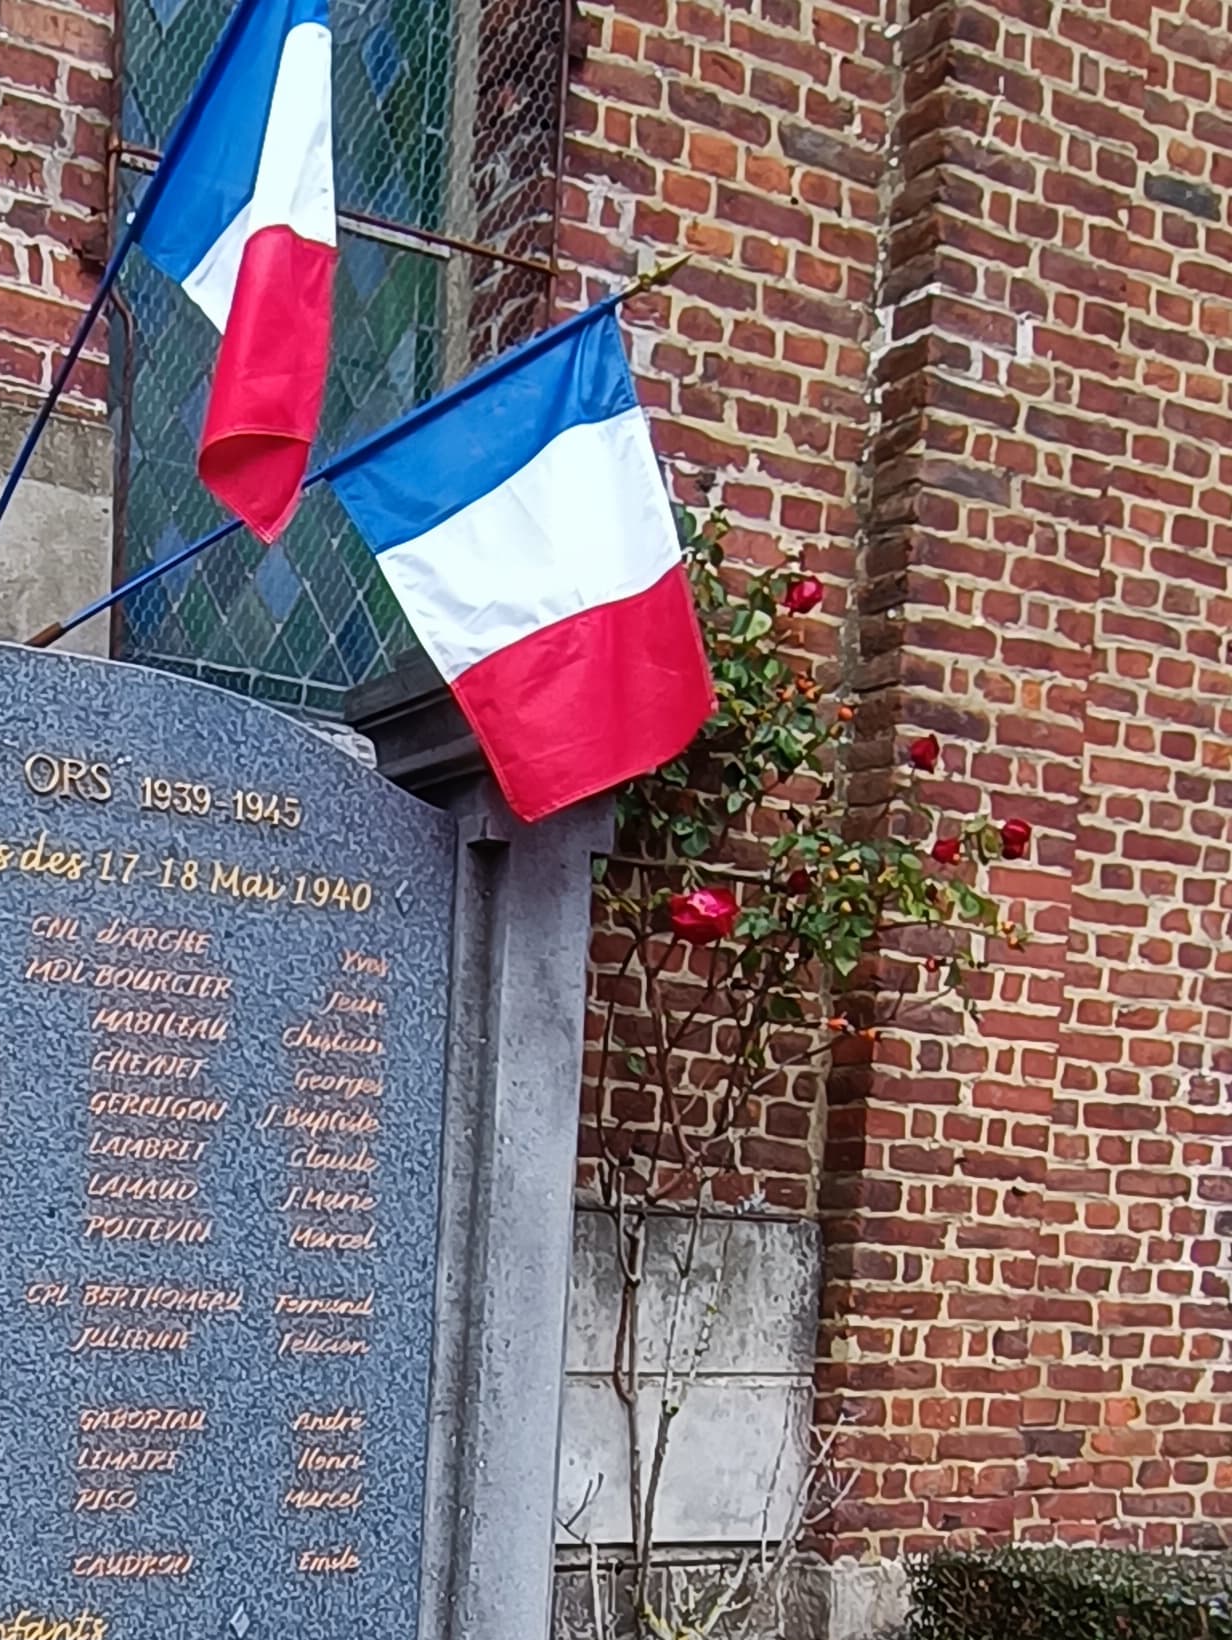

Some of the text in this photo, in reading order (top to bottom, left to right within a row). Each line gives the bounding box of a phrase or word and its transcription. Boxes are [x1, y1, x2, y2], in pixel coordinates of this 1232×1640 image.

[24, 753, 113, 801] ORS
[140, 776, 302, 828] 1939-1945
[20, 830, 90, 882] des
[210, 860, 287, 901] Mai
[293, 874, 372, 913] 1940
[341, 949, 389, 978] Yves
[320, 991, 386, 1016] Jean
[295, 1068, 384, 1100] Georges
[289, 1143, 376, 1172] Claude
[289, 1225, 376, 1251] Marcel
[297, 1447, 365, 1471] Henri
[285, 1484, 363, 1509] Marcel
